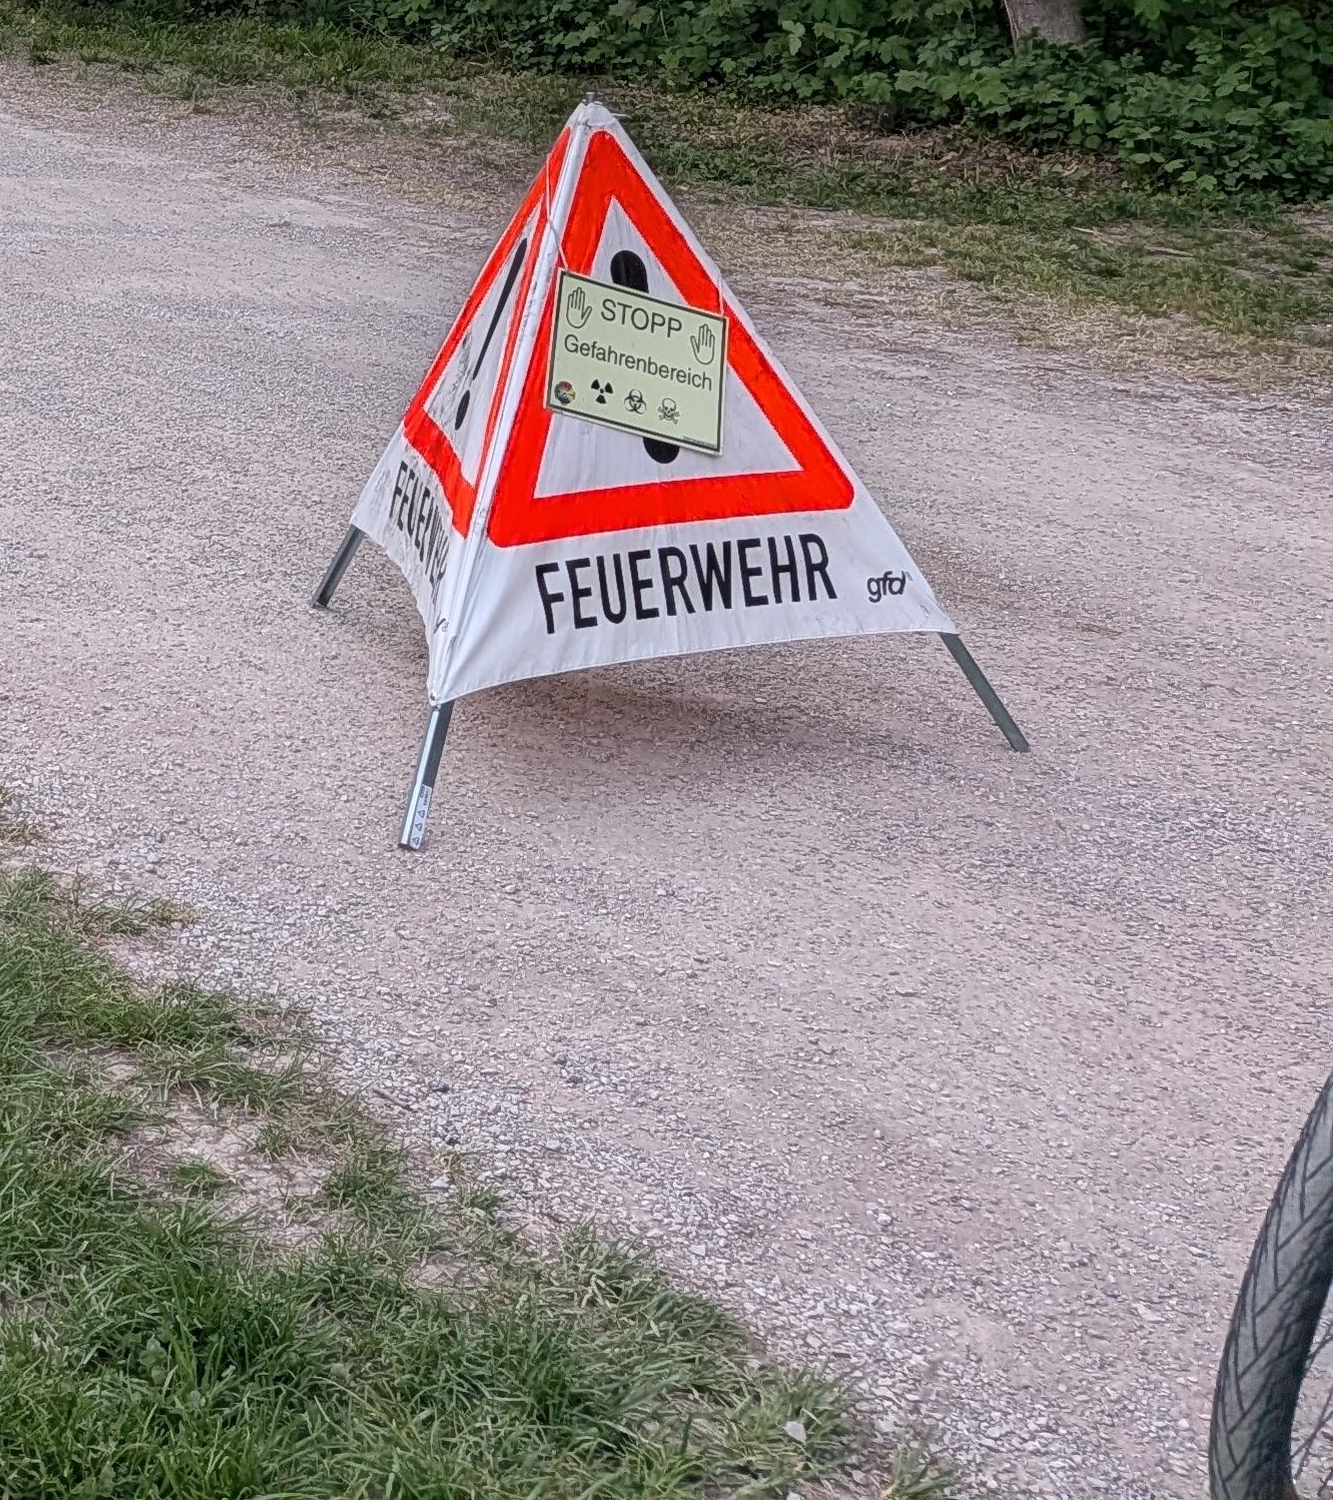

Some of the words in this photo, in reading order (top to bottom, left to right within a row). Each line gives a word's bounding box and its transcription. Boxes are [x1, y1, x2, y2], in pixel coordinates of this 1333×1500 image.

[601, 299, 682, 338] STOPP
[564, 334, 712, 391] Gefahrenbereich
[535, 533, 837, 634] FEUERWEHR
